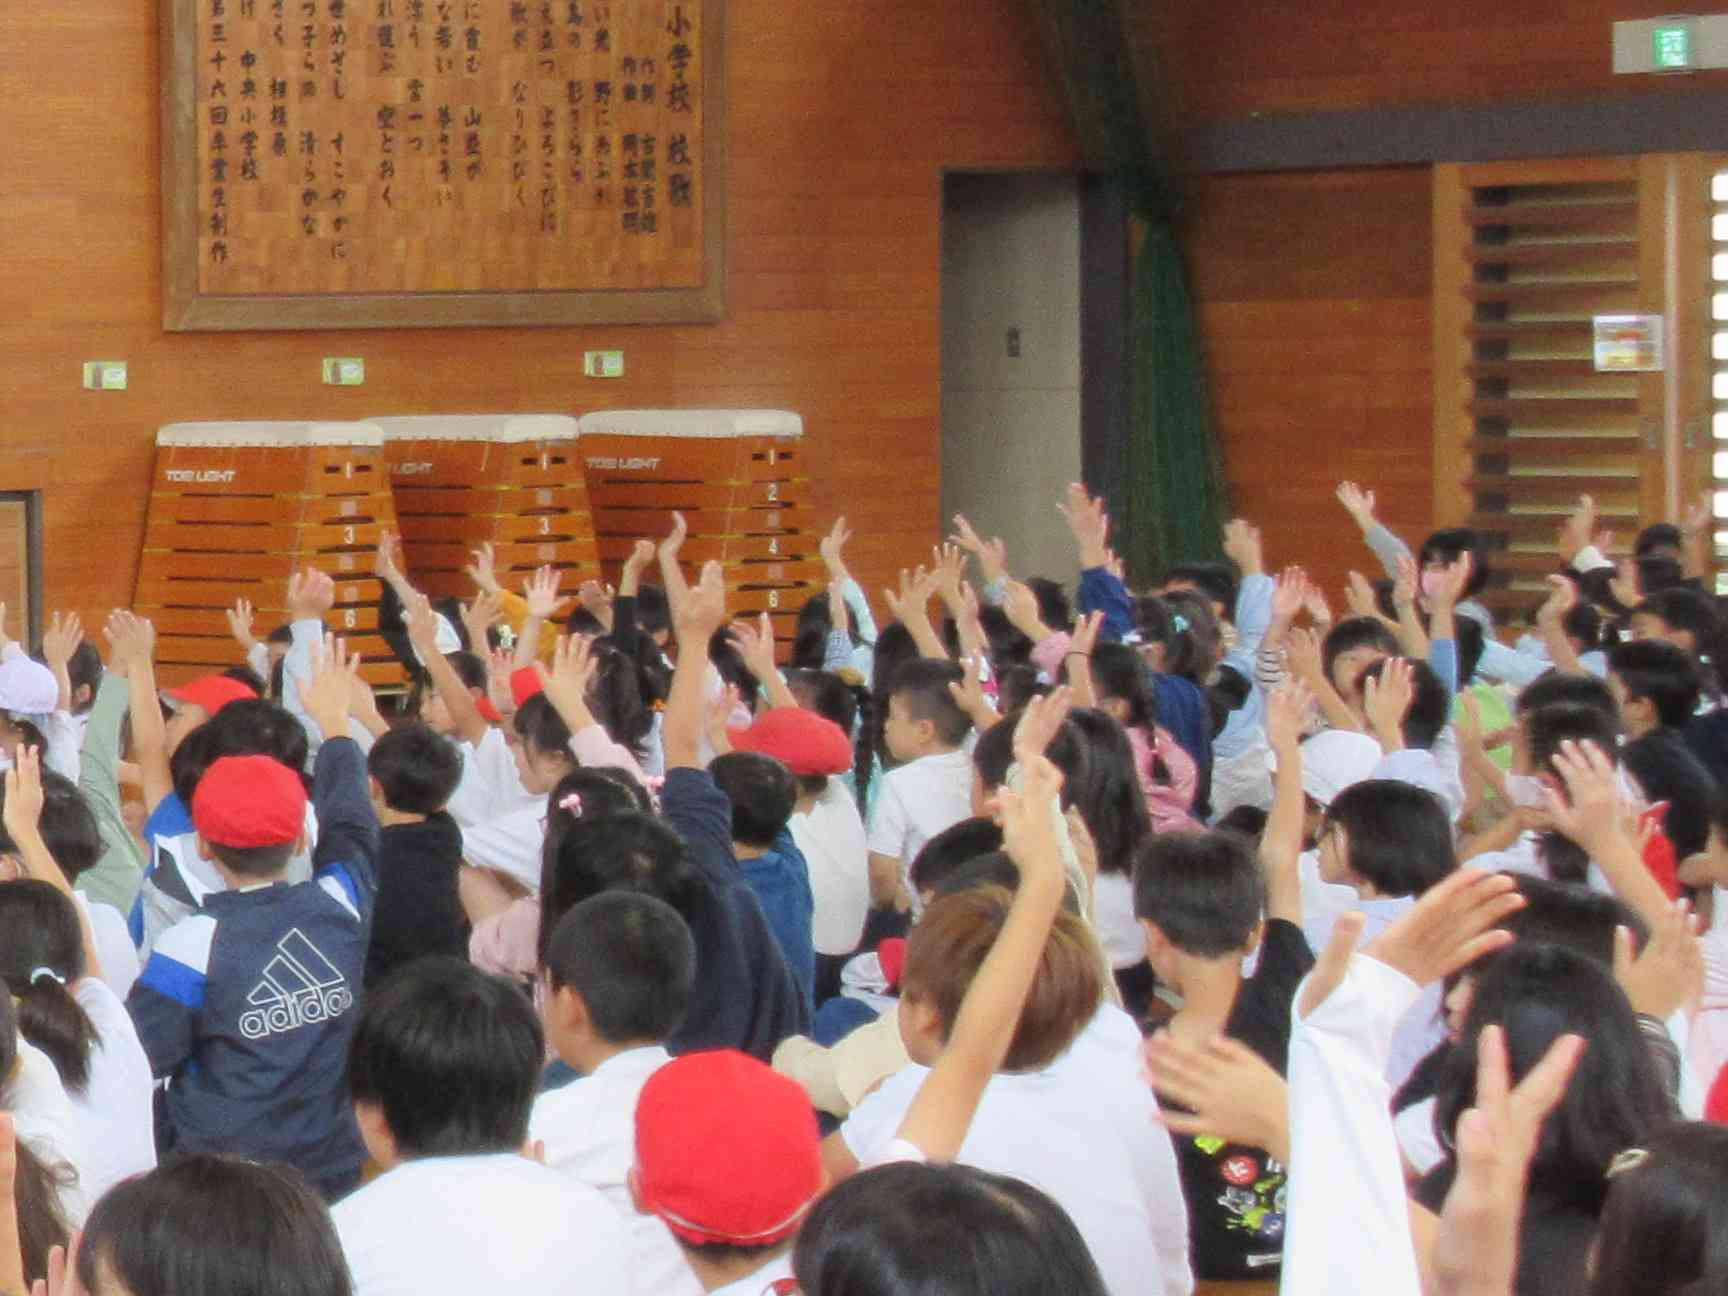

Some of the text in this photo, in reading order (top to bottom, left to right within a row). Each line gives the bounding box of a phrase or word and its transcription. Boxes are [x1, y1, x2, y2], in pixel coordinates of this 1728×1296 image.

[239, 49, 260, 182] 中央小学校
[267, 78, 289, 158] 相模原
